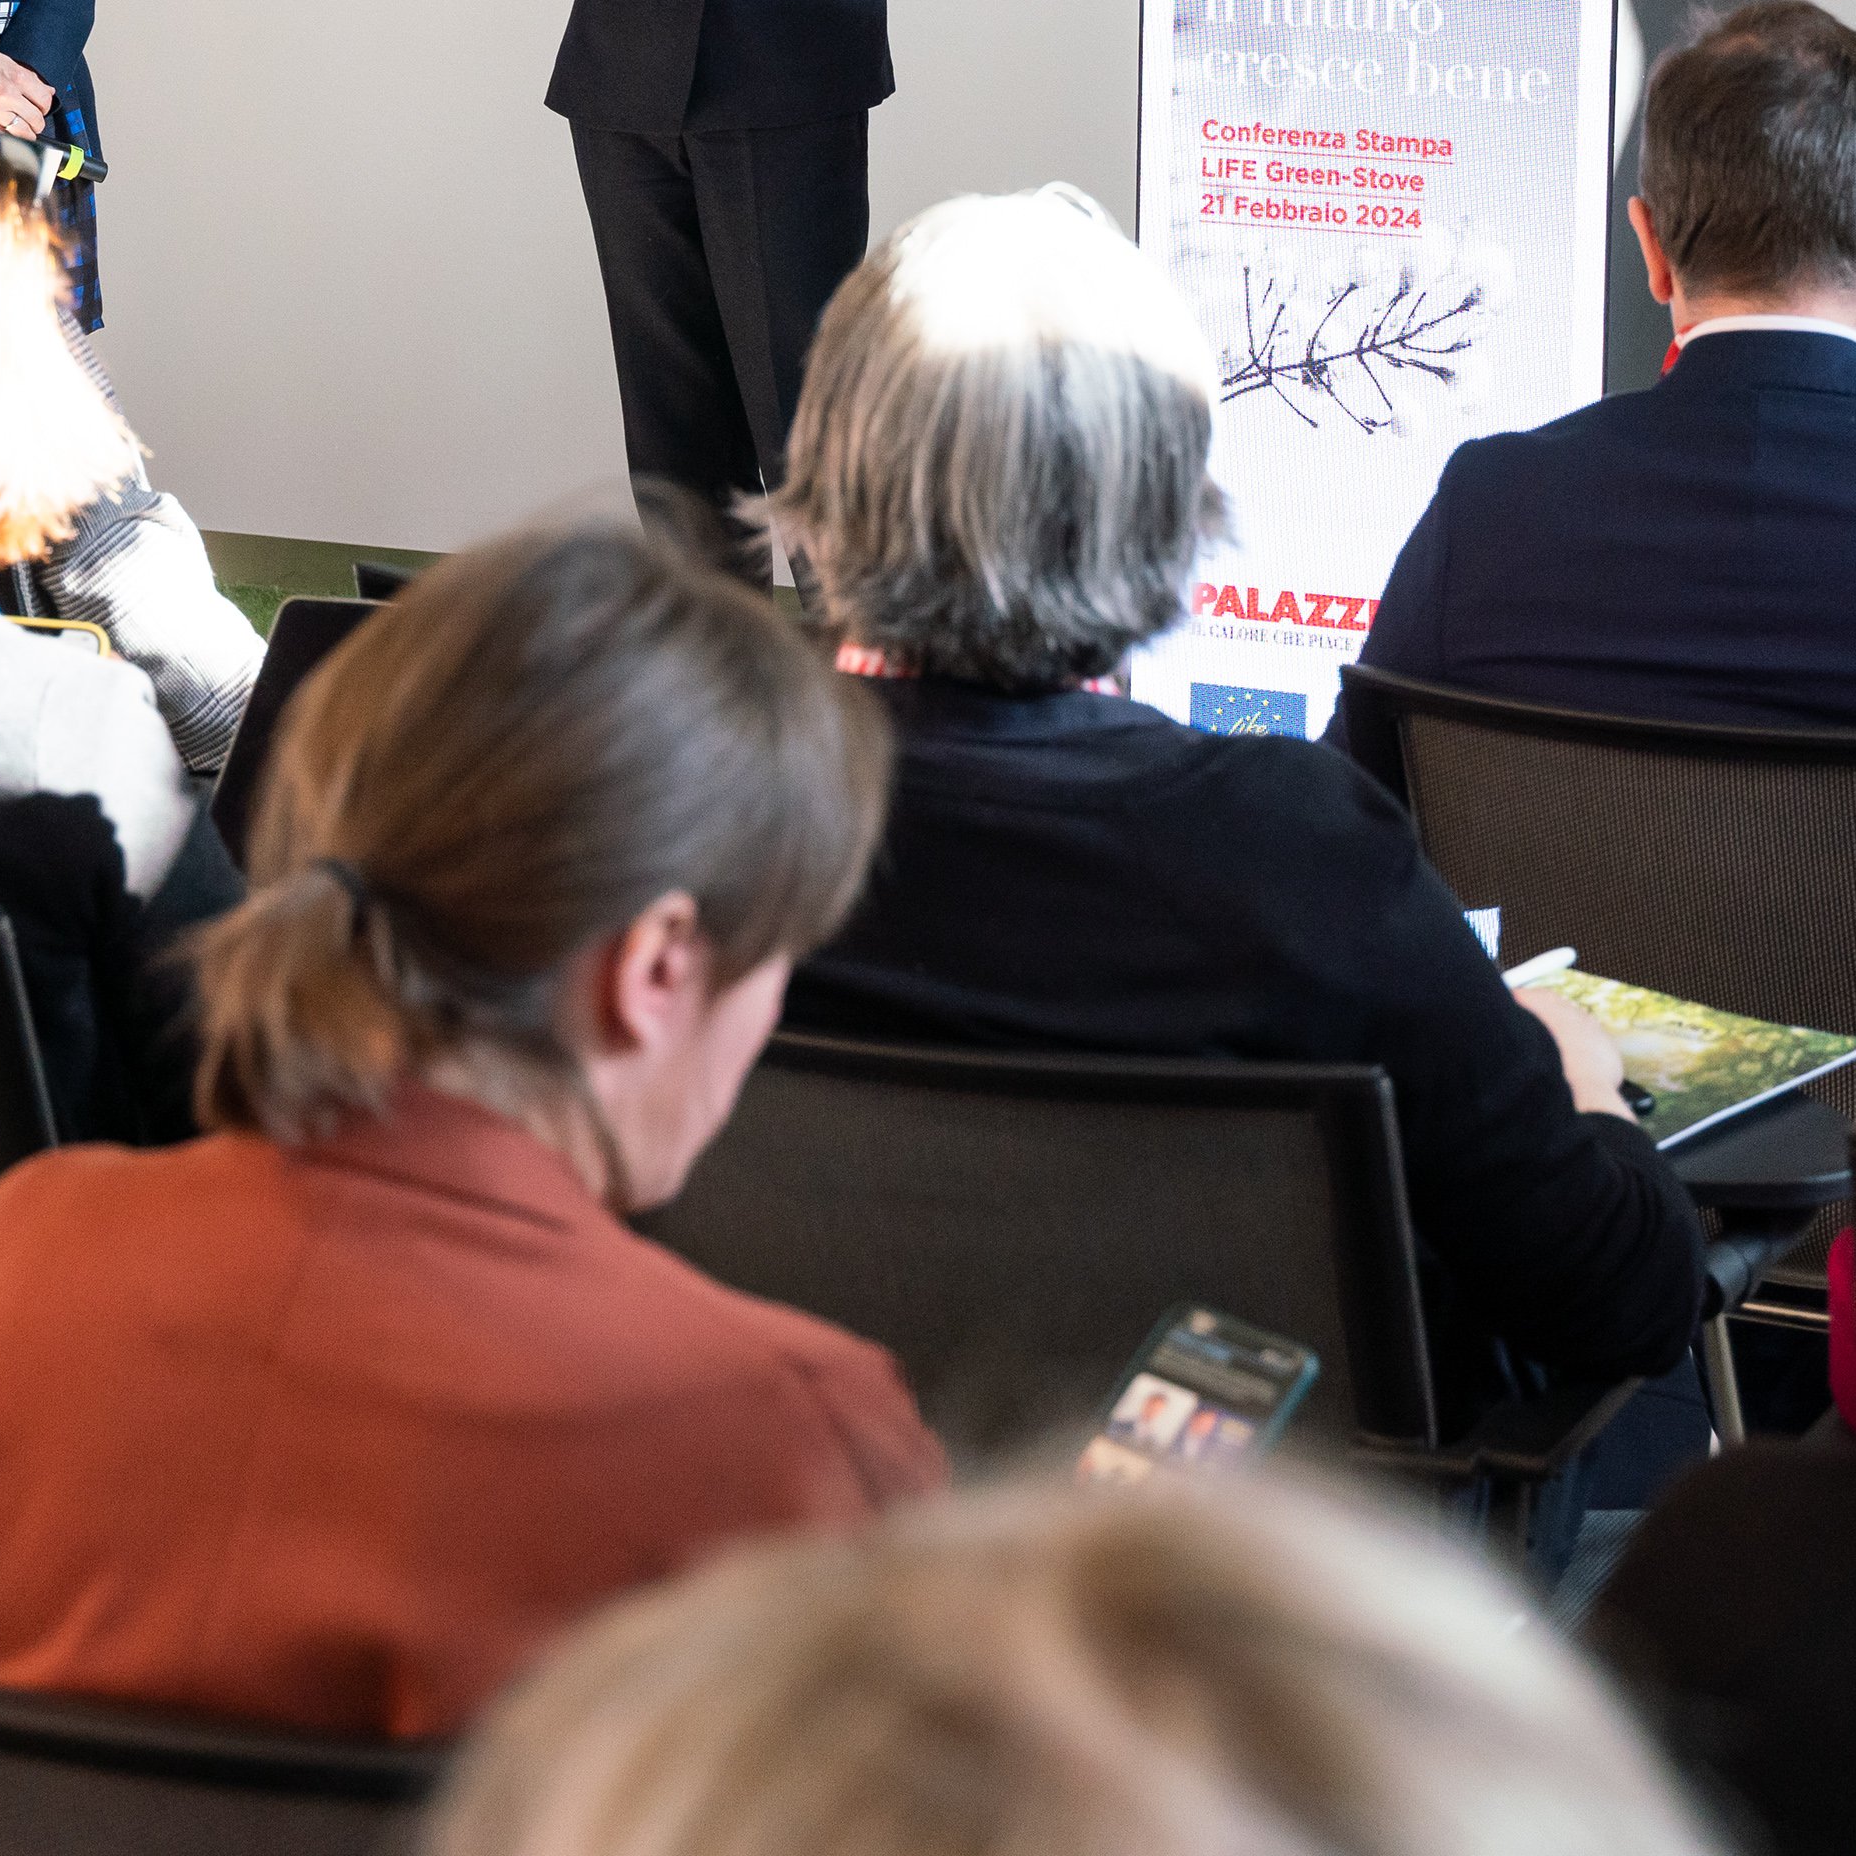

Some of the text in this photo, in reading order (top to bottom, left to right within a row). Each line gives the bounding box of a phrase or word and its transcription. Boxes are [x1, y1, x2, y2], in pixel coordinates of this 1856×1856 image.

[1201, 40, 1551, 102] cresce bene
[1201, 119, 1453, 159] Conferenza Stampa
[1201, 157, 1425, 192] LIFE Green-Stove
[1200, 194, 1422, 229] 21 Febbraio 2024
[1209, 624, 1268, 644] CALORE
[1274, 629, 1304, 646] CHE
[1309, 633, 1353, 651] PIACE
